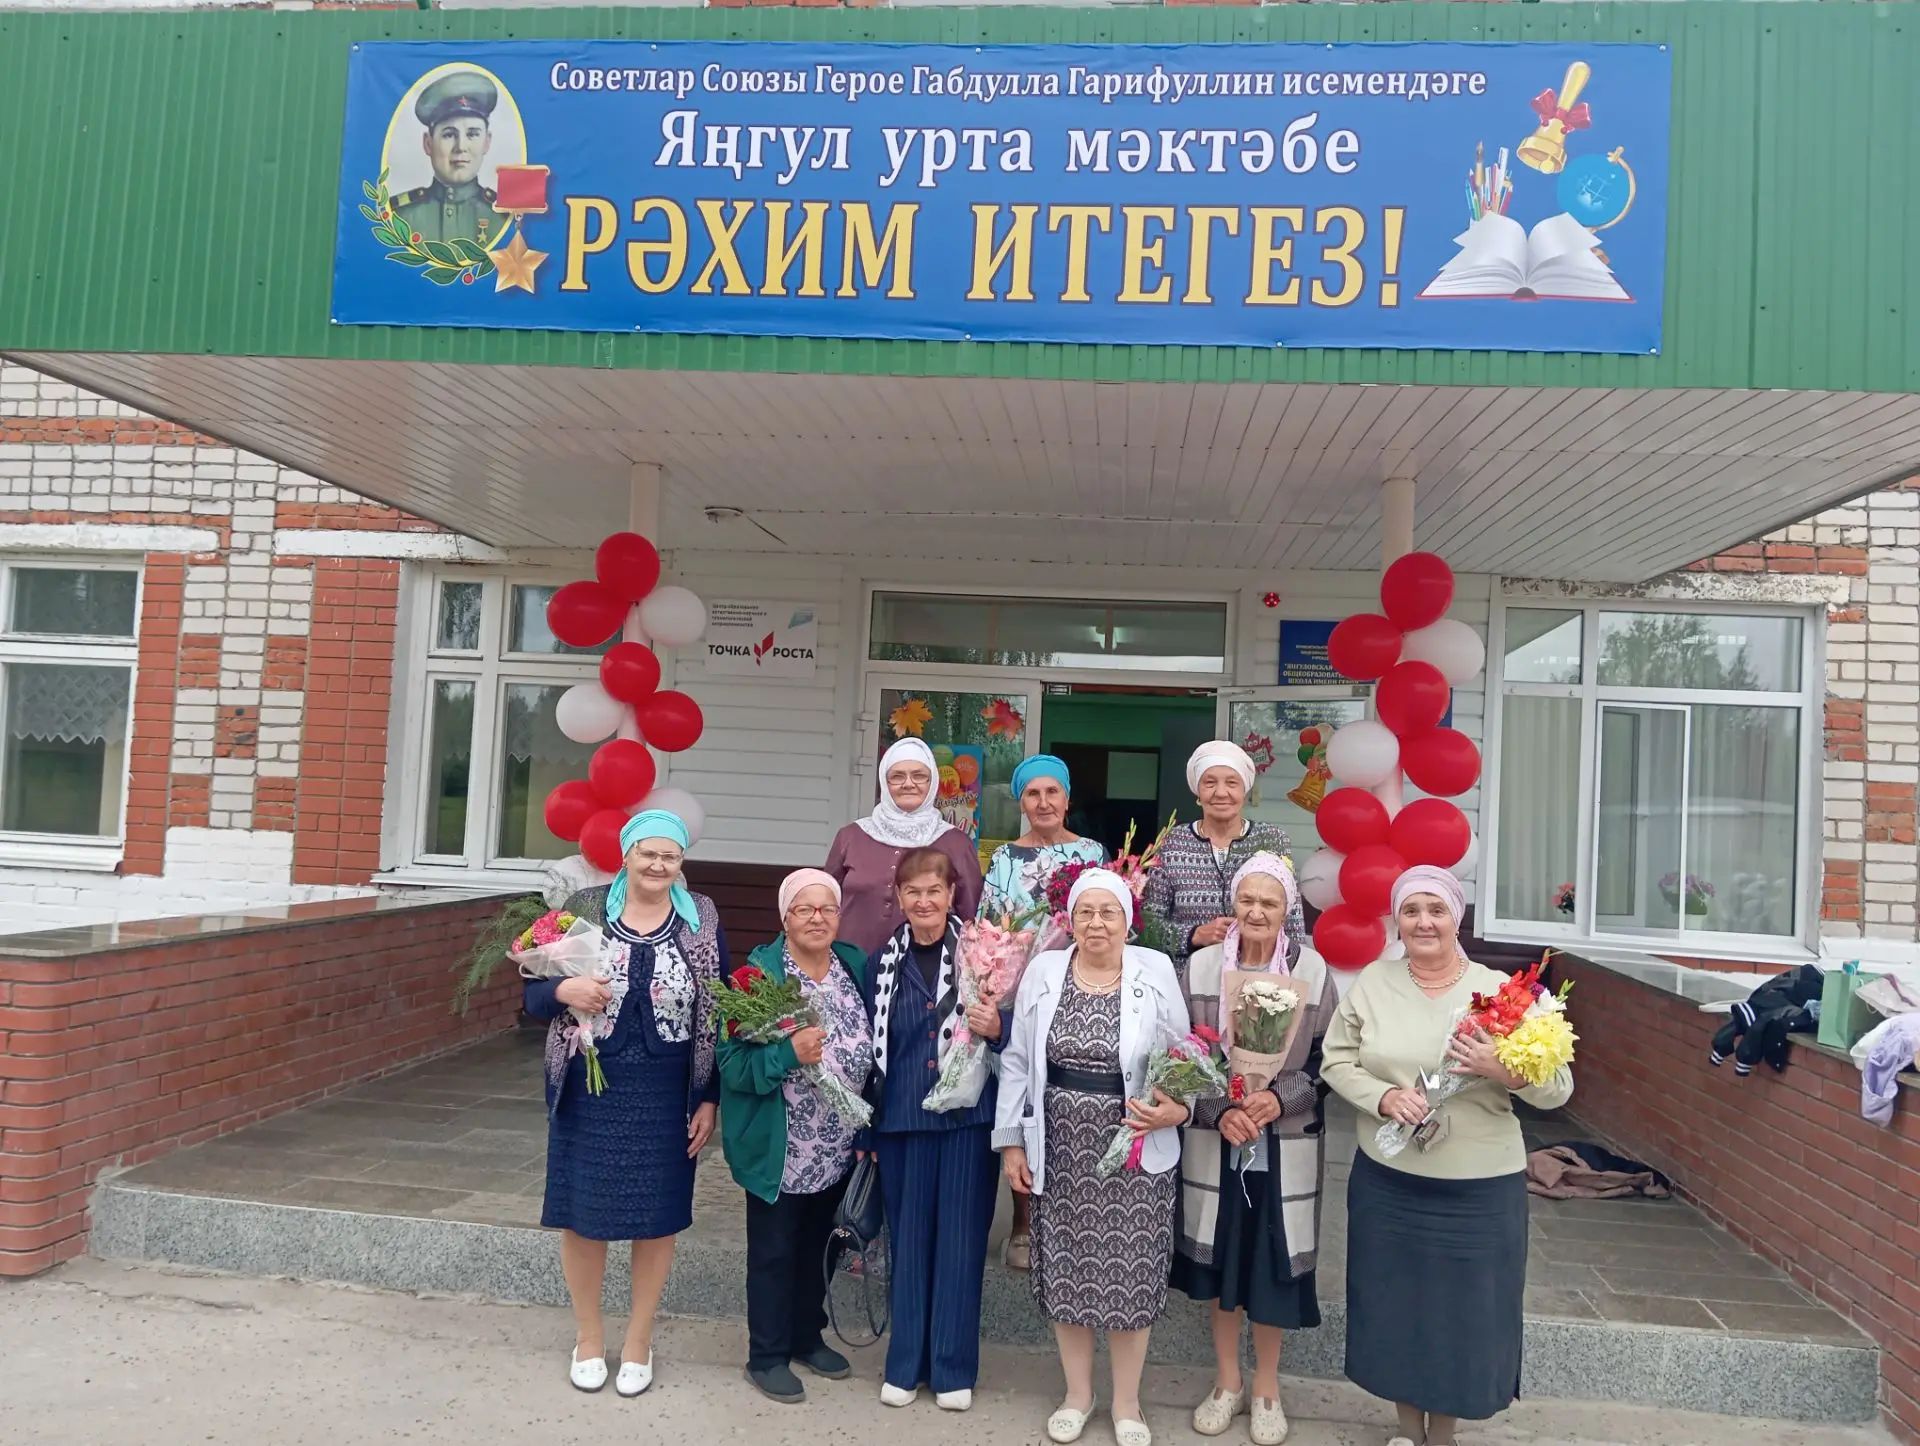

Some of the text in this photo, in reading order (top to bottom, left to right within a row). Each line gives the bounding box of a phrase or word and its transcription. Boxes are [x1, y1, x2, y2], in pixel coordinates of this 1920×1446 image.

[550, 61, 1487, 104] Советлар Союзы Герое Габдулла Гарифуллин исемендәге
[653, 109, 1360, 188] Яңгул урта мәктәбе
[560, 196, 1405, 307] РӘХИМ ИТЕГЕЗ!
[708, 644, 814, 659] ТОЧКА РОСТА
